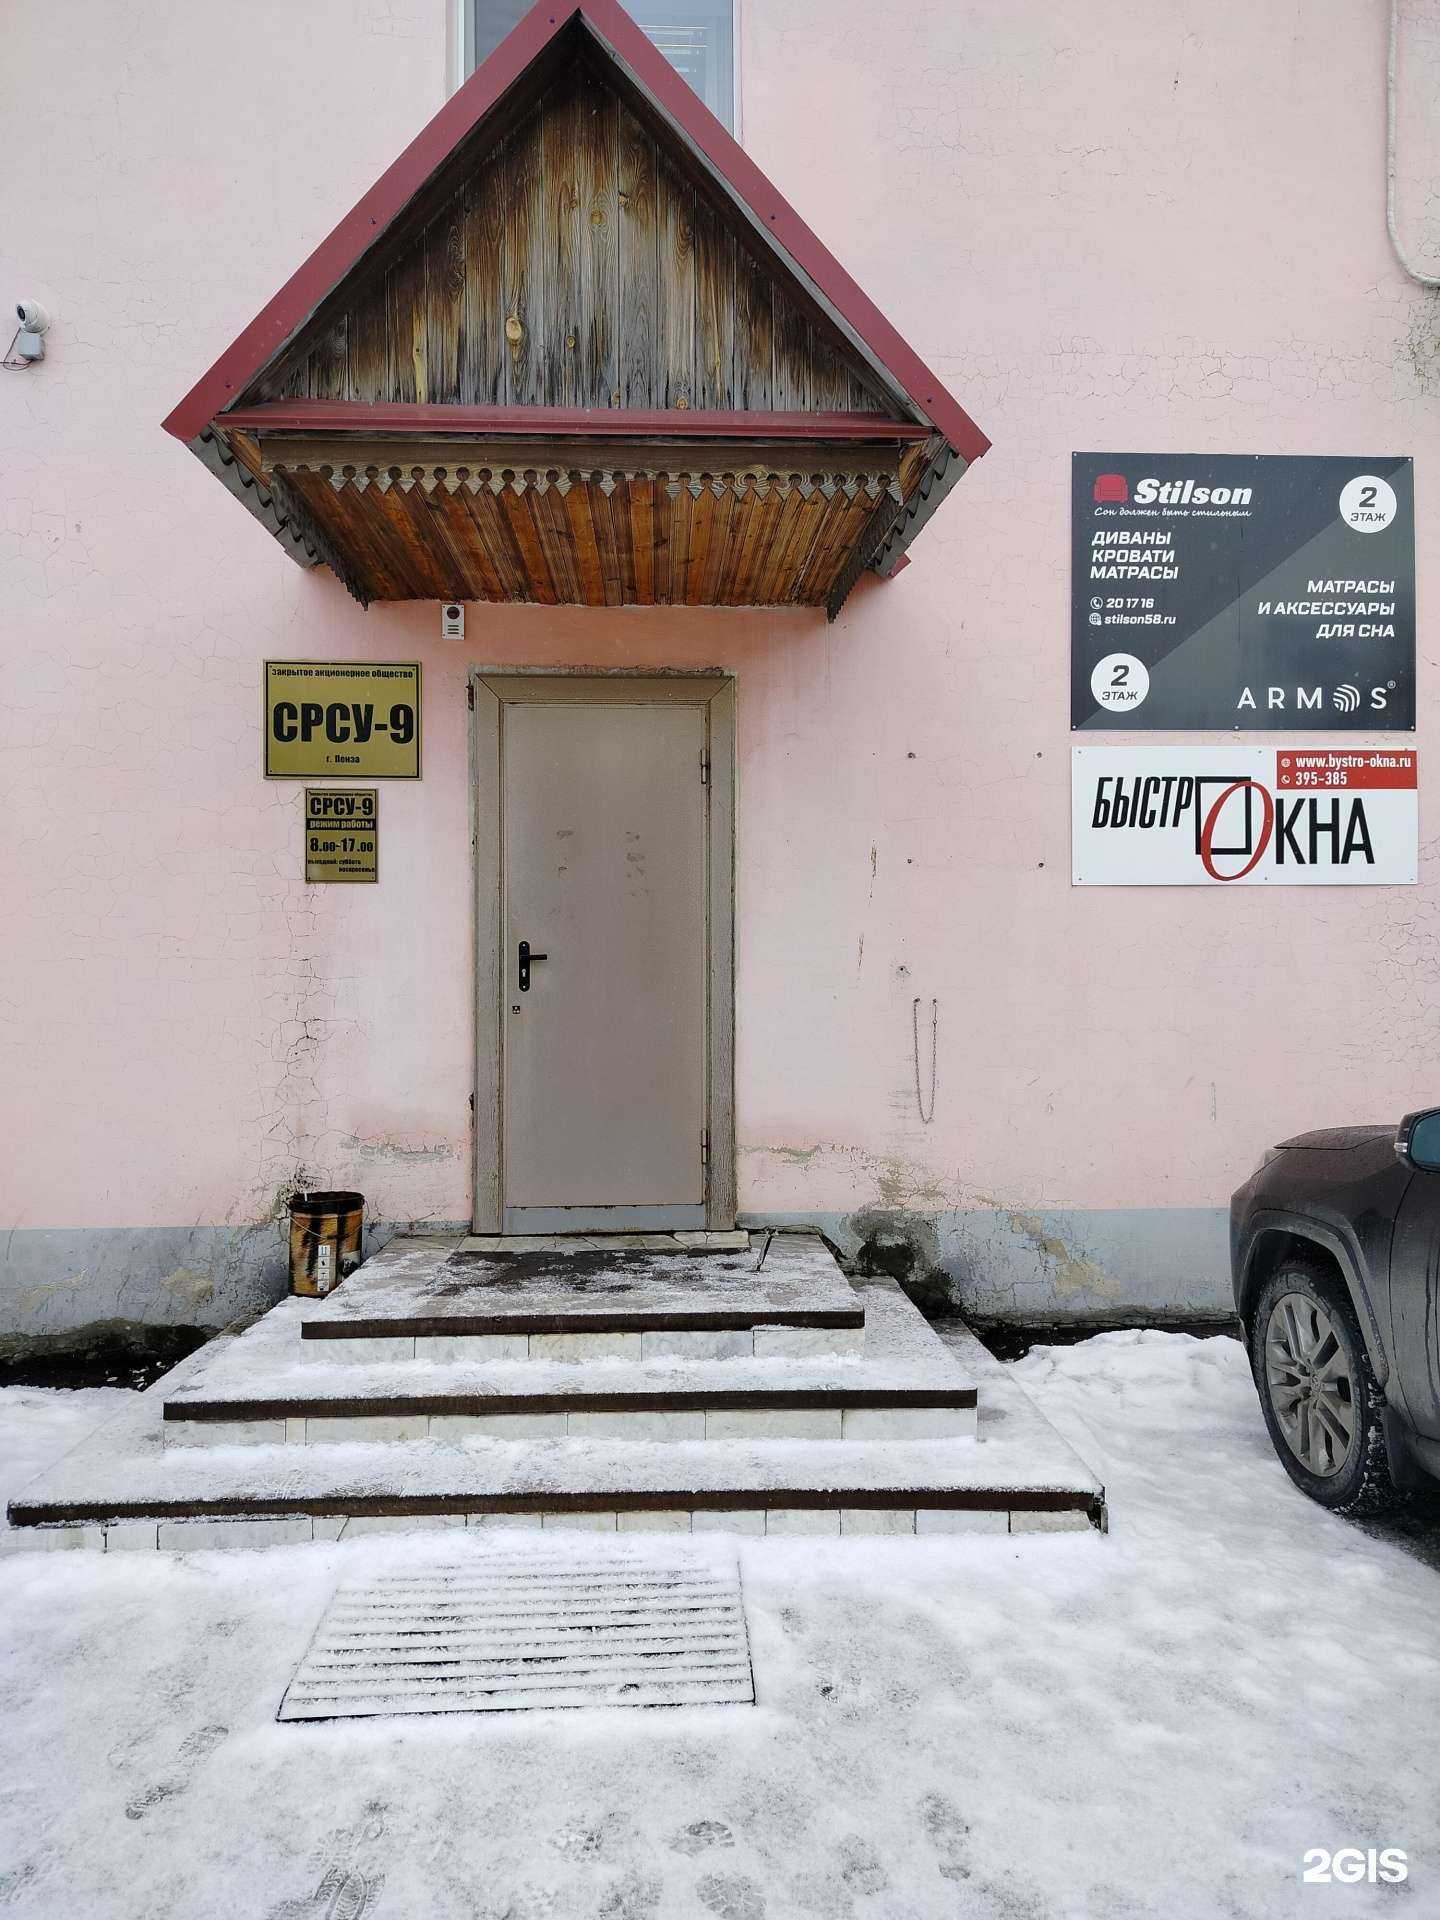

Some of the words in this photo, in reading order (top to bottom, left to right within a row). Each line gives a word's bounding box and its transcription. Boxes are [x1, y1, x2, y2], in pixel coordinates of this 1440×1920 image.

[1134, 478, 1253, 504] Stilson
[1359, 487, 1377, 508] 2
[1094, 508, 1117, 516] Сон
[1119, 507, 1160, 516] должен
[1162, 507, 1189, 516] быть
[1350, 512, 1386, 523] ЭТАЖ
[1091, 531, 1171, 546] ДИВАНЫ
[1092, 550, 1175, 563] КРОВАТИ
[1090, 566, 1178, 579] МАТРАСЫ
[1307, 580, 1394, 593] МАТРАСЫ
[1106, 598, 1123, 608] 20
[1258, 603, 1271, 615] И
[1274, 602, 1394, 615] АКСЕССУАРЫ
[1104, 614, 1176, 624] stilson58.ru
[1316, 624, 1355, 639] ДЛЯ
[1358, 624, 1394, 638] СНА
[315, 670, 370, 678] акционерное
[372, 670, 413, 678] общество
[1110, 665, 1129, 686] 2
[1102, 691, 1138, 701] ЭТАЖ
[273, 702, 414, 744] СРСУ-9
[335, 755, 360, 763] Пенза
[1296, 754, 1411, 769] www.bystro-okna.ru
[1296, 771, 1347, 786] 395-385
[310, 797, 373, 815] СРСУ-9
